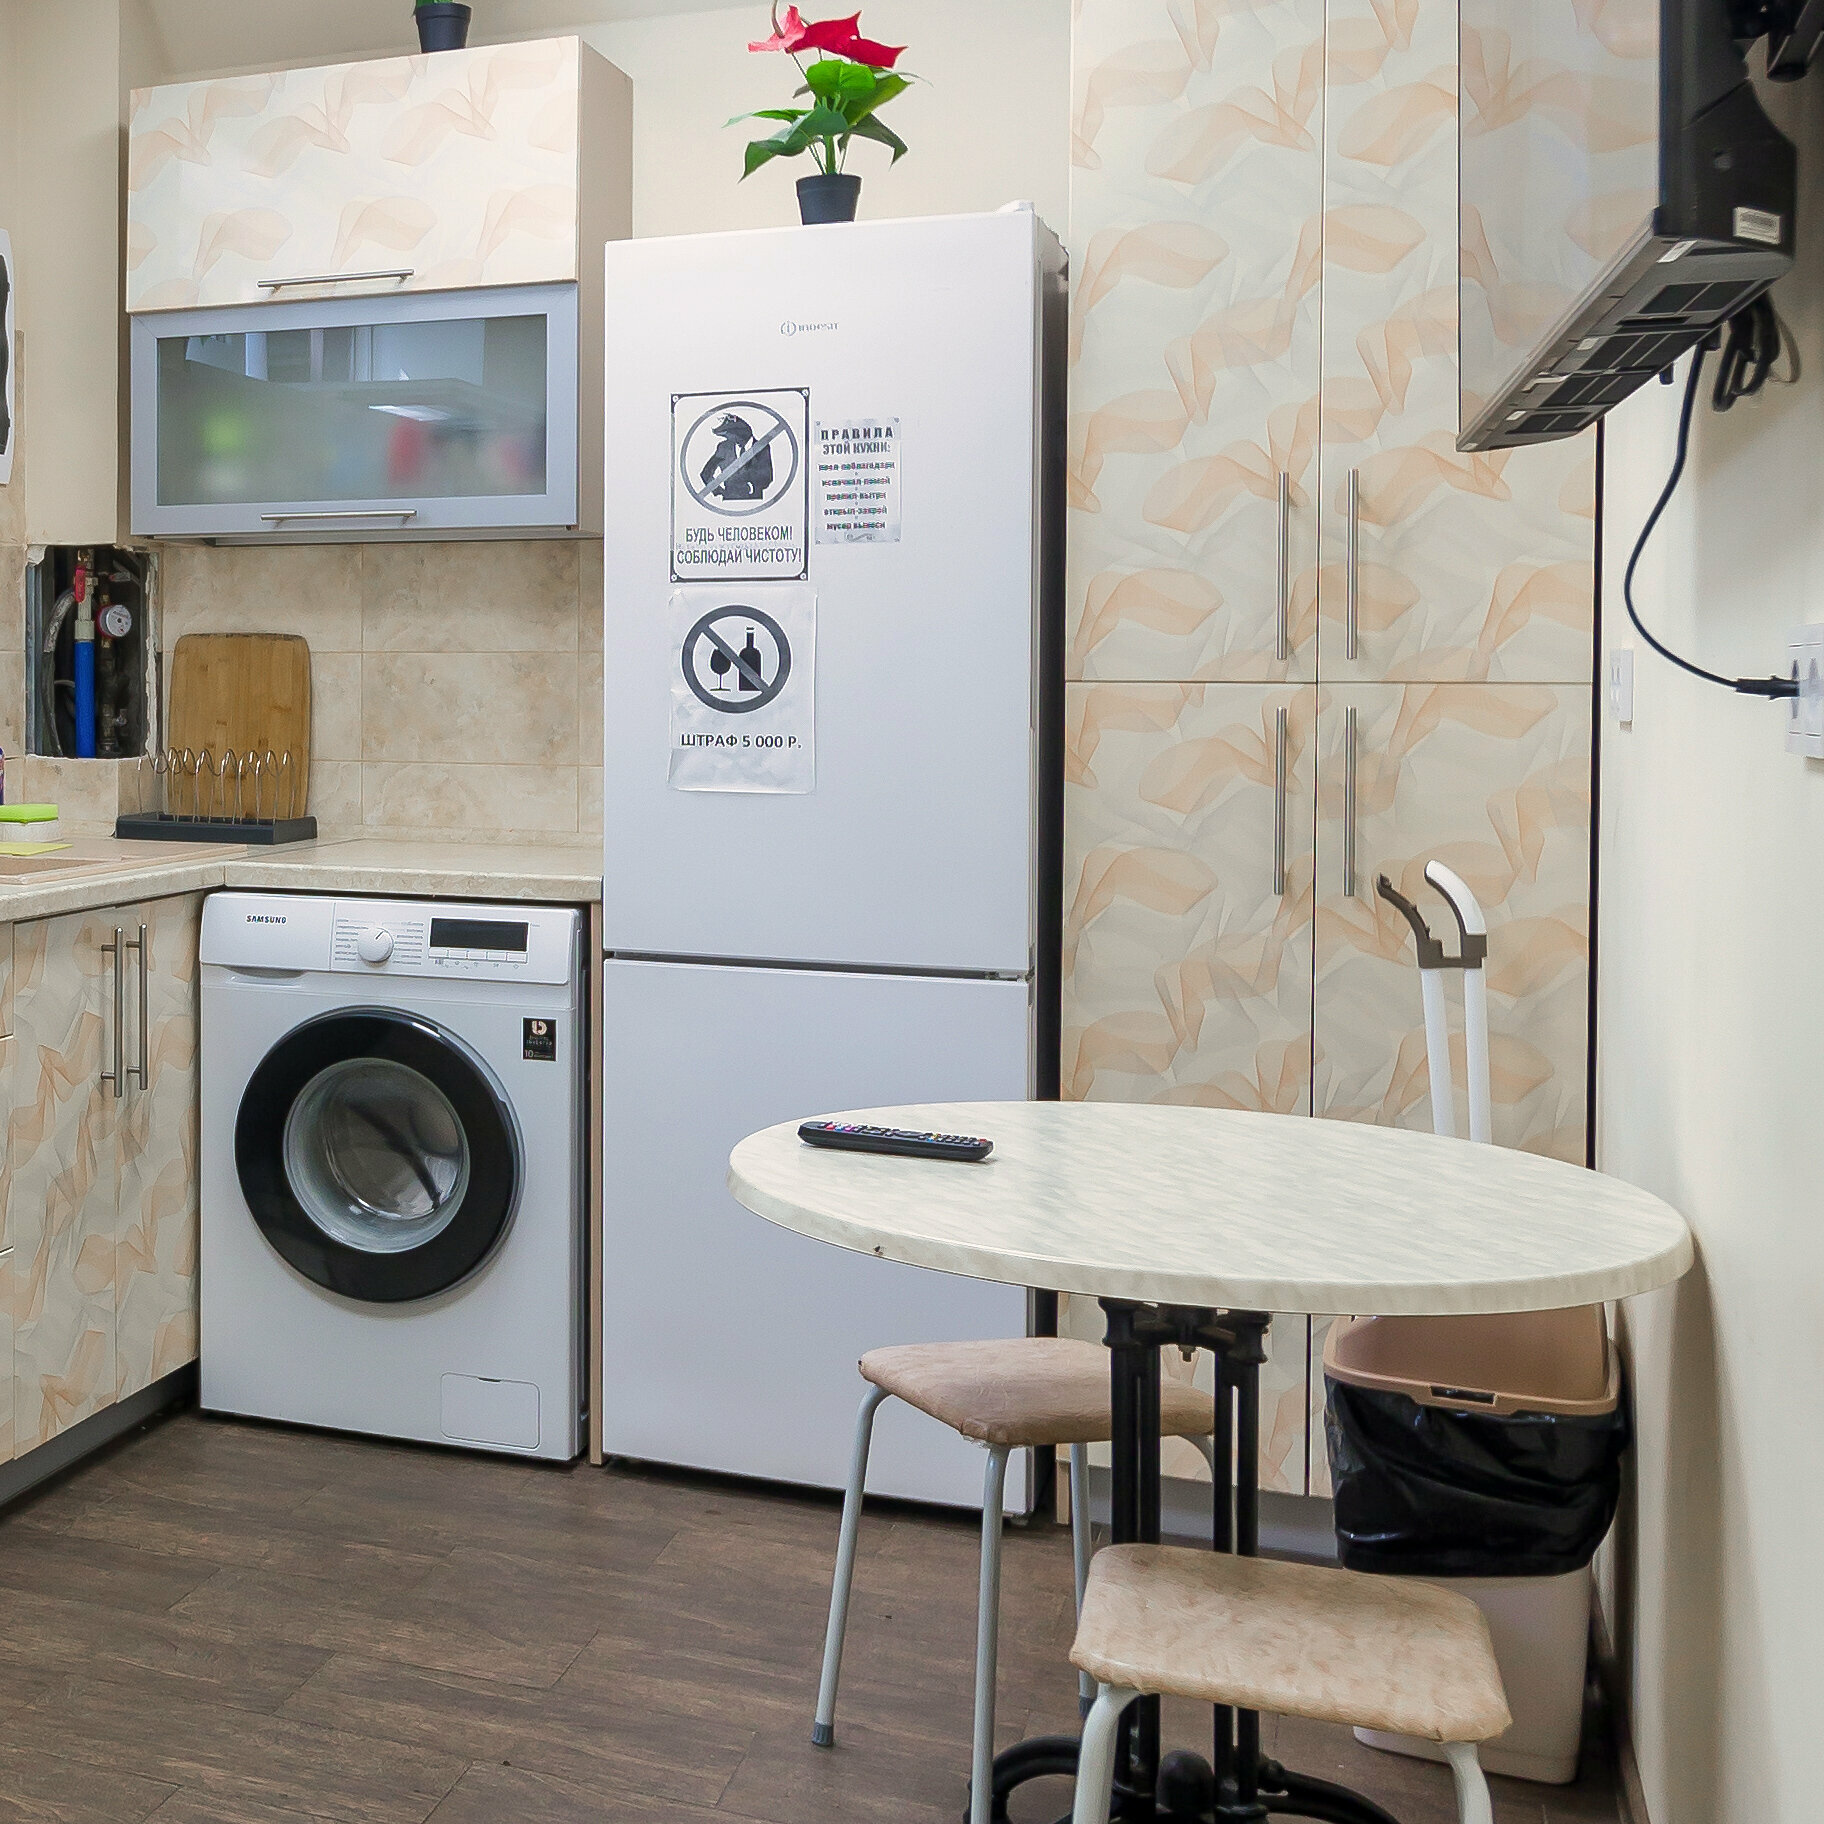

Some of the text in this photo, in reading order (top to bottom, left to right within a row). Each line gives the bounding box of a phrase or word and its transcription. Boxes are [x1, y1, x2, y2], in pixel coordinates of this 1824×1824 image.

[821, 427, 893, 440] ПРАВИЛА
[823, 441, 891, 455] ЭТОЙ КУХНИ:
[686, 526, 793, 545] БУДЬ ЧЕЛОВЕКОМ!
[676, 548, 802, 566] СОБЛЮДАЙ ЧИСТОТУ!
[681, 734, 802, 749] ШТРАФ 5 000 Р.
[246, 915, 287, 924] SAMSUNG
